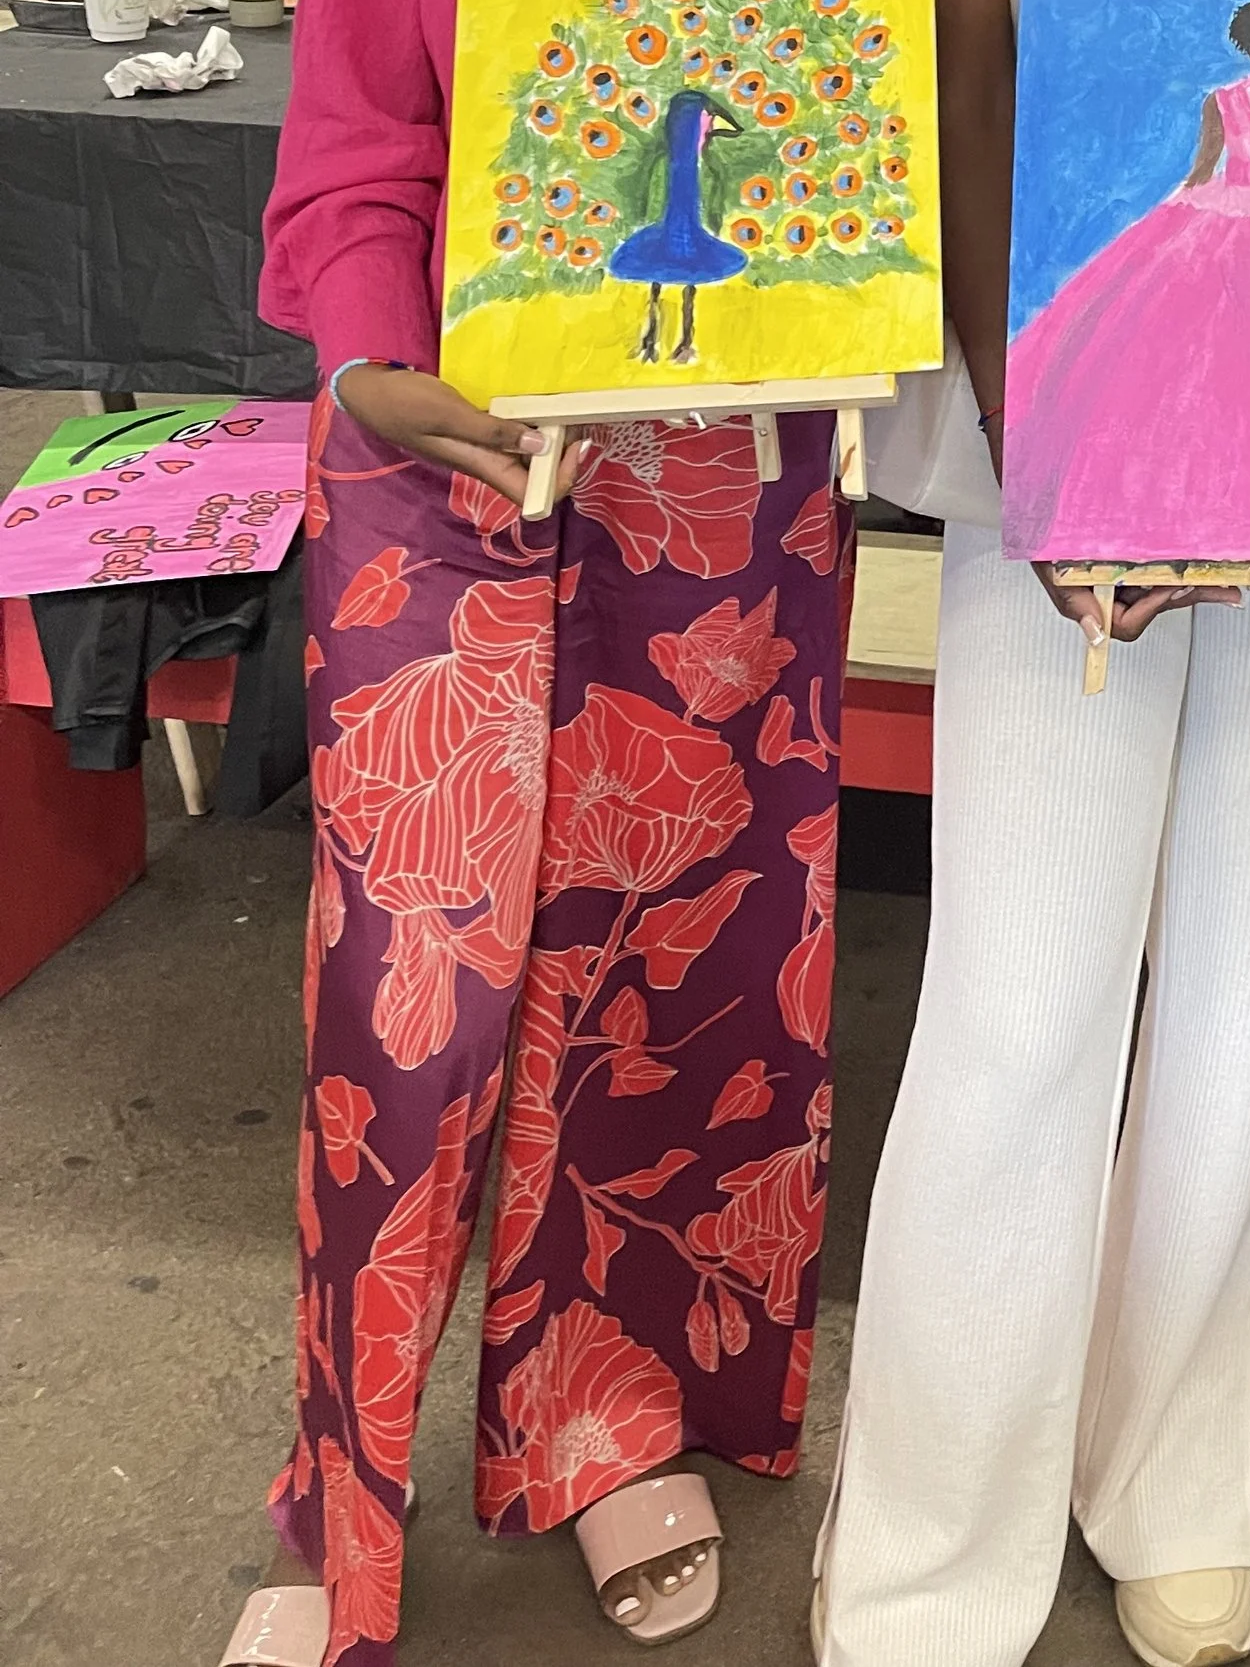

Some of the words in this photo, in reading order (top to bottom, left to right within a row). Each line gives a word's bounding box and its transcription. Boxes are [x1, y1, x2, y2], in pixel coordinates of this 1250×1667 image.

[150, 492, 249, 553] doing
[238, 489, 306, 527] you
[206, 533, 261, 572] are
